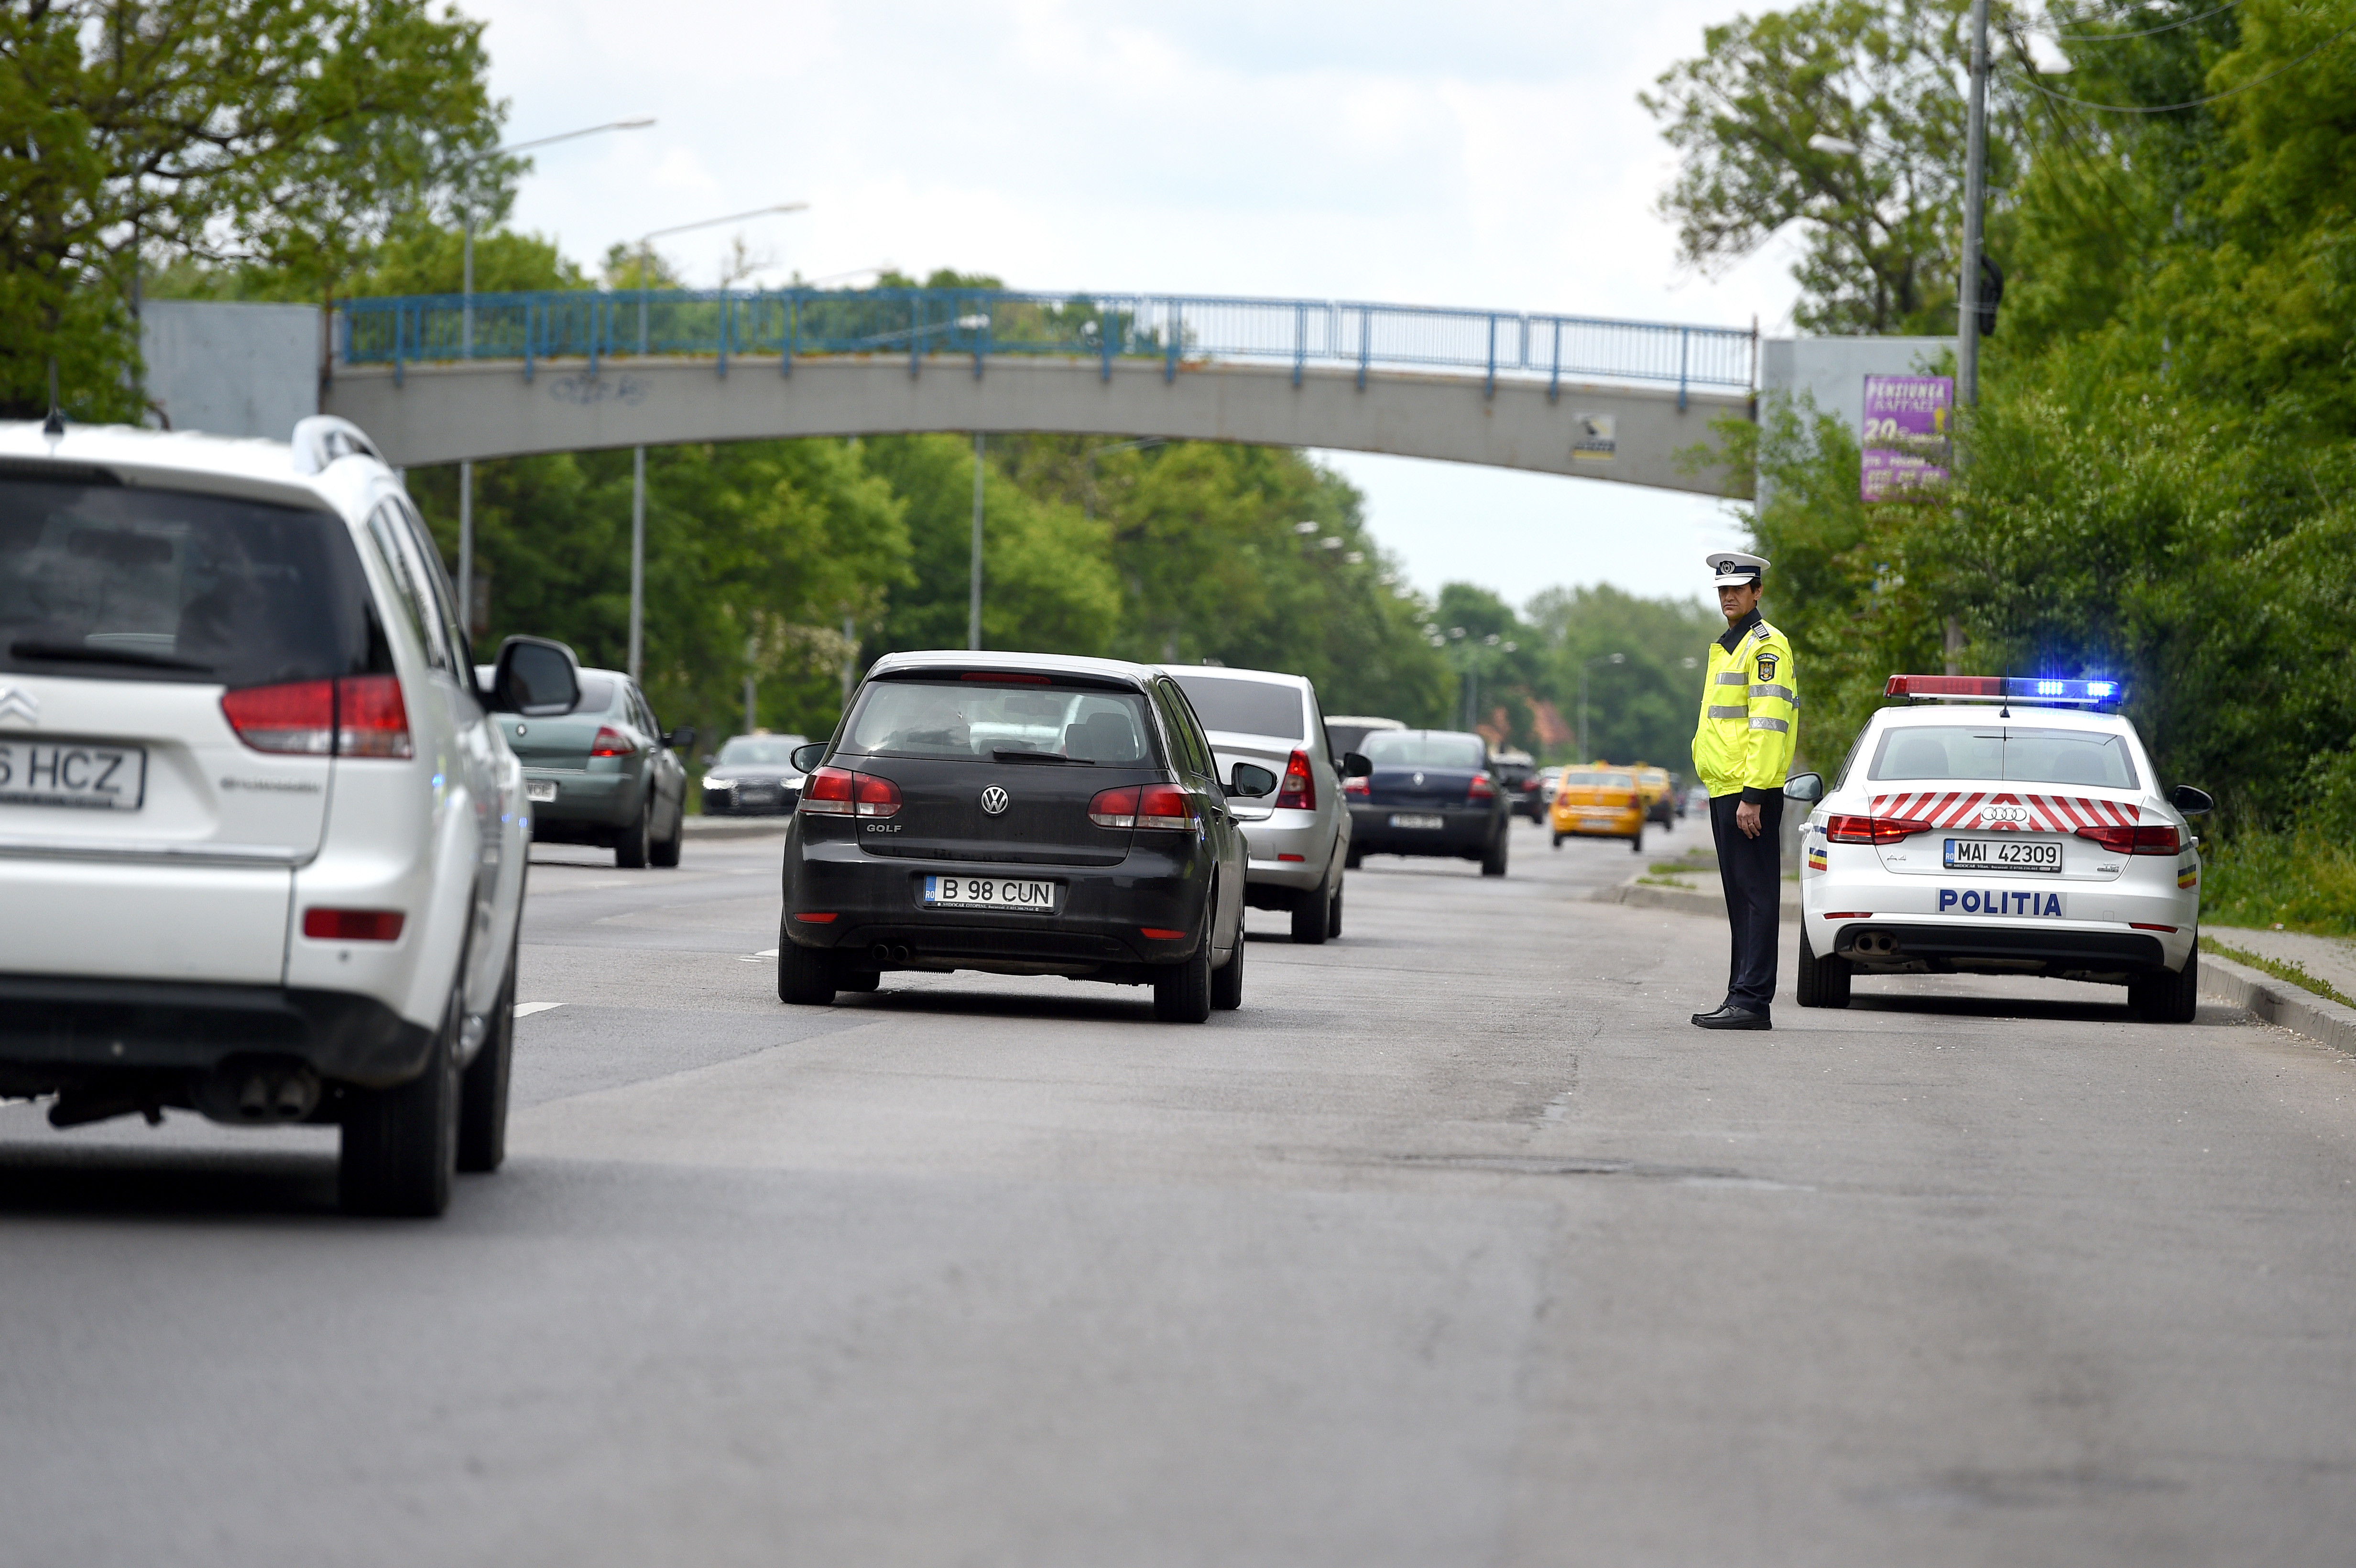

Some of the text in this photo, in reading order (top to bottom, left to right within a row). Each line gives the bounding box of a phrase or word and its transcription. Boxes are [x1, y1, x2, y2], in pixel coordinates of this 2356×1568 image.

[29, 748, 123, 794] HCZ
[866, 824, 902, 832] GOLF
[1887, 852, 1907, 860] A4
[1958, 843, 2056, 864] MAI 42309
[925, 891, 935, 899] RO
[943, 879, 1049, 904] B 98 CUN
[1939, 889, 2062, 916] POLITIA
